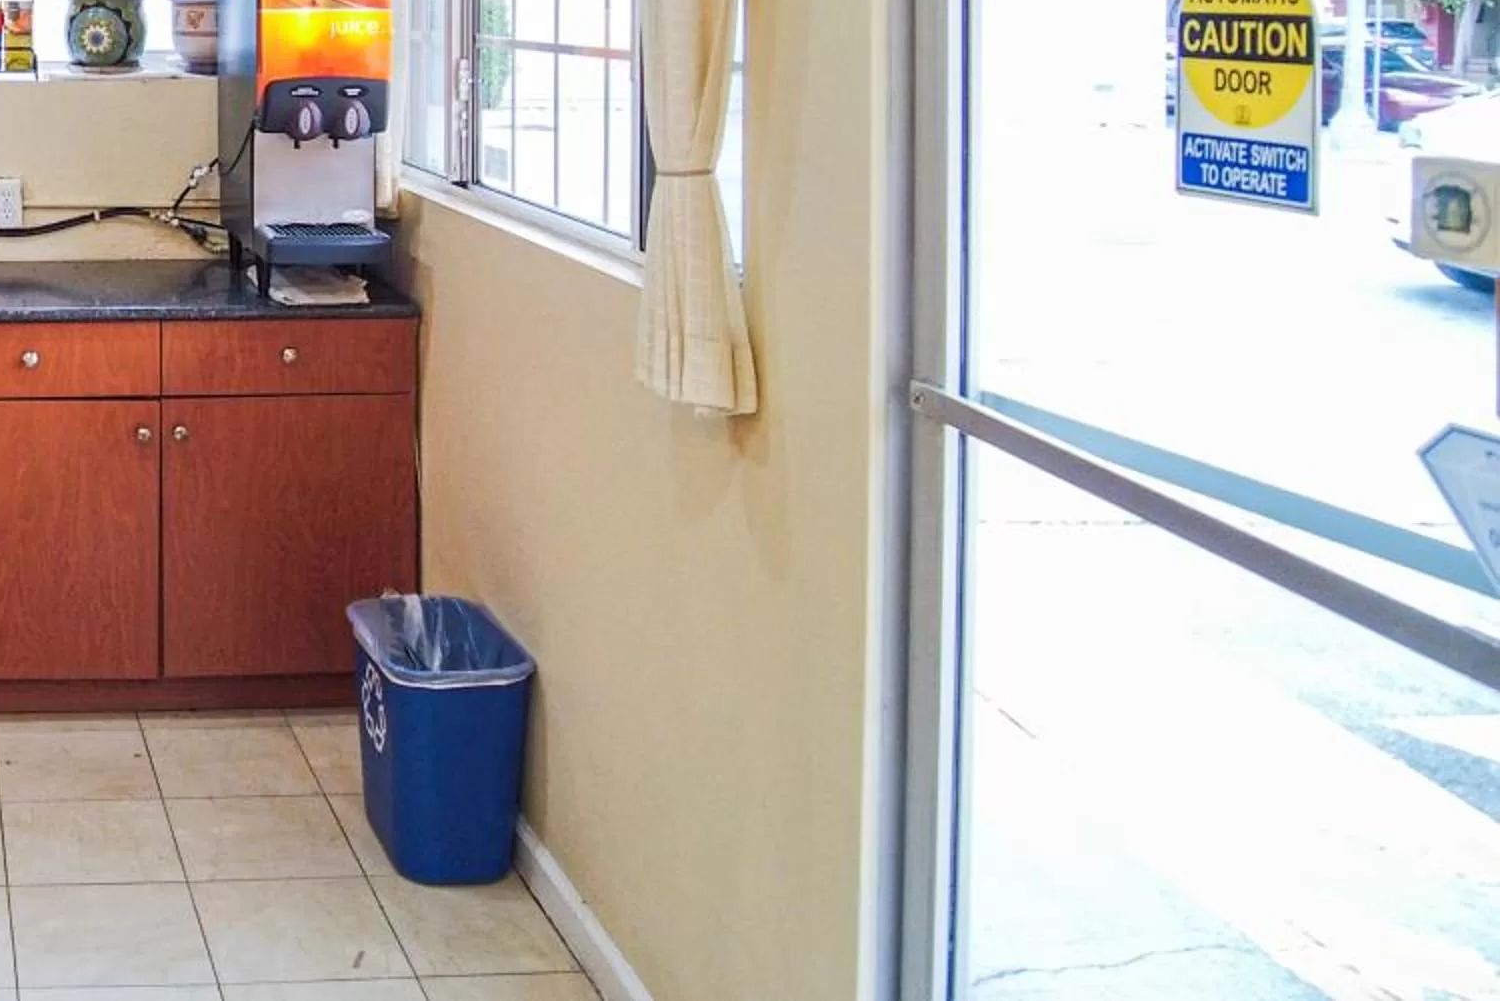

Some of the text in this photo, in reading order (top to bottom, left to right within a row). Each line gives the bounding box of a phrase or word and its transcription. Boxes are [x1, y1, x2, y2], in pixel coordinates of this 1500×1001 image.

[1182, 18, 1308, 58] CAUTION
[1214, 67, 1272, 96] DOOR
[1184, 136, 1307, 172] ACTIVATE SWITCH
[1200, 162, 1287, 197] TO OPERATE
